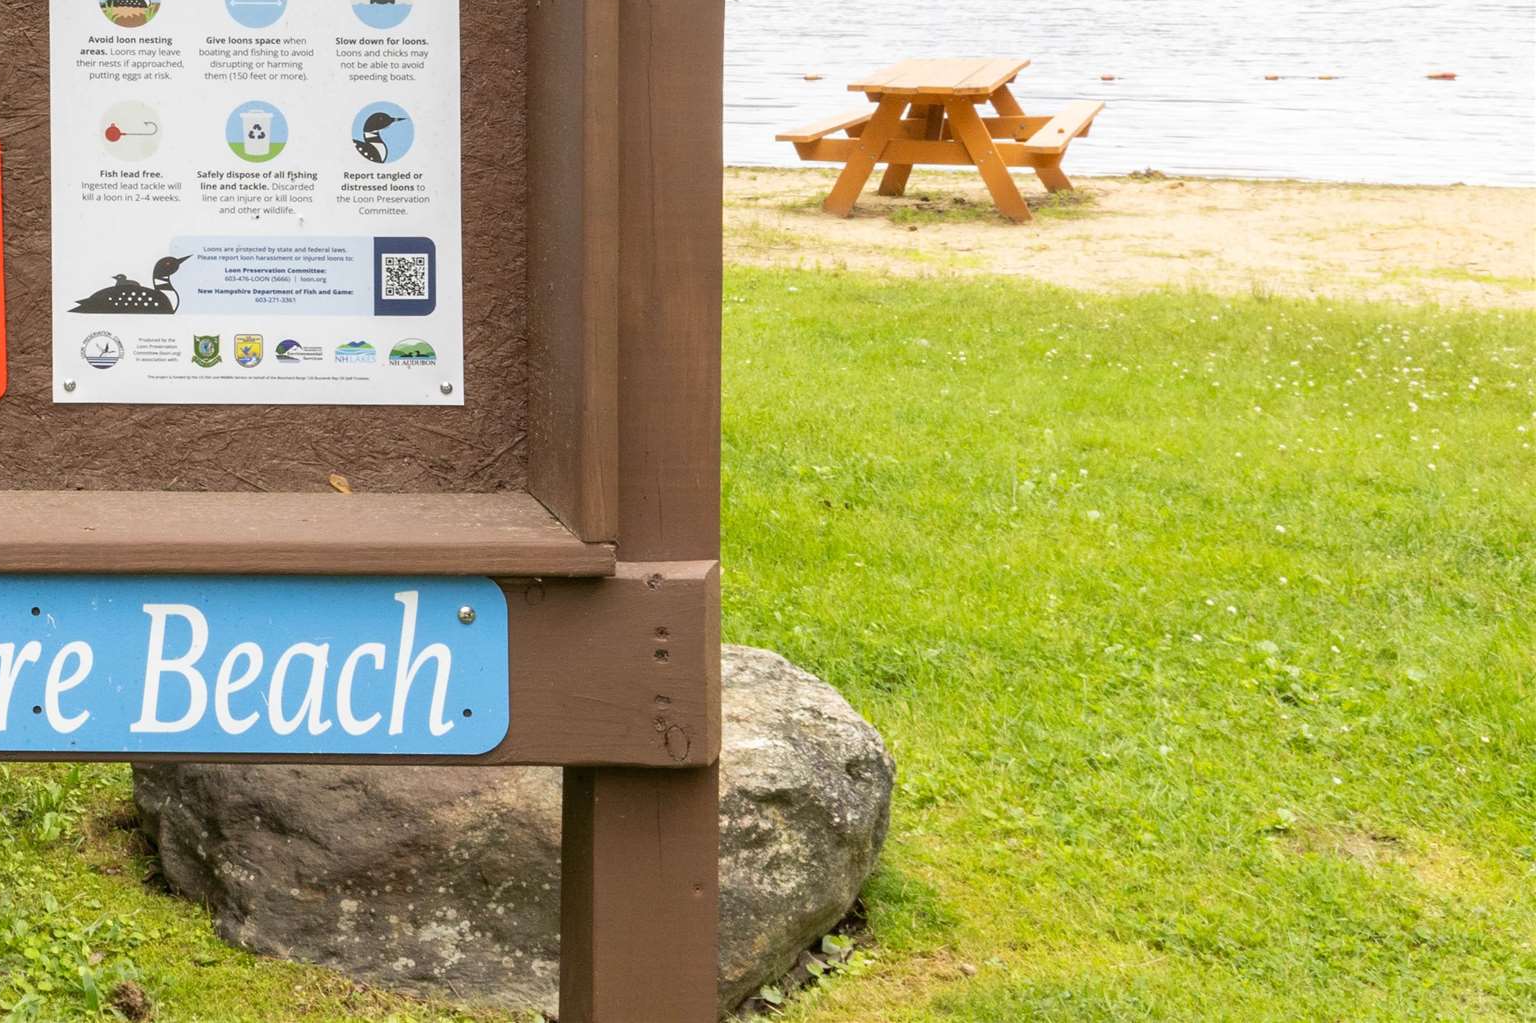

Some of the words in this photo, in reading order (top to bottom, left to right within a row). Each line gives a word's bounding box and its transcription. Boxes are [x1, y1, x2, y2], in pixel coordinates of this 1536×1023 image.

[88, 35, 114, 43] Avoid
[116, 35, 136, 43] loon
[139, 35, 172, 46] nesting
[206, 36, 226, 44] Give
[228, 36, 252, 44] loons
[256, 38, 280, 46] space
[283, 36, 306, 44] when
[336, 36, 356, 45] Slow
[359, 36, 384, 45] down
[387, 36, 400, 45] for
[402, 36, 429, 45] loons.
[111, 47, 136, 55] Loons
[138, 49, 156, 57] may
[159, 47, 180, 55] leave
[199, 47, 231, 58] boating
[232, 47, 248, 56] and
[251, 47, 278, 58] fishing
[292, 47, 314, 56] avoid
[336, 48, 362, 56] Loons
[364, 48, 380, 56] and
[383, 48, 408, 56] chicks
[410, 50, 428, 59] may
[76, 59, 96, 67] their
[124, 59, 130, 67] if
[132, 59, 185, 69] approached,
[210, 59, 253, 70] disrupting
[267, 59, 303, 70] harming
[358, 60, 368, 68] be
[370, 60, 388, 68] able
[402, 60, 424, 68] avoid
[89, 71, 120, 81] putting
[122, 73, 141, 81] eggs
[154, 71, 171, 79] risk.
[204, 71, 227, 80] them
[229, 71, 248, 82] (150
[250, 71, 266, 80] feet
[280, 71, 307, 82] more).
[350, 72, 388, 83] speeding
[390, 72, 416, 80] boats.
[100, 169, 118, 178] Fish
[121, 169, 140, 178] lead
[143, 169, 163, 178] free.
[197, 170, 224, 180] Safely
[226, 170, 260, 180] dispose
[263, 170, 272, 178] of
[274, 170, 284, 178] all
[288, 170, 318, 180] fishing
[344, 171, 374, 181] Report
[377, 171, 410, 181] tangled
[82, 181, 118, 192] Ingested
[120, 181, 138, 190] lead
[140, 181, 165, 190] tackle
[168, 181, 181, 190] will
[201, 182, 217, 190] line
[220, 182, 236, 190] and
[239, 182, 270, 190] tackle.
[272, 182, 314, 190] Discarded
[341, 182, 387, 191] distressed
[390, 182, 414, 191] loons
[82, 193, 94, 201] kill
[104, 193, 122, 201] loon
[125, 193, 132, 201] in
[152, 193, 181, 201] weeks.
[202, 193, 217, 202] line
[237, 193, 262, 204] injure
[276, 193, 287, 202] kill
[290, 193, 312, 202] loons
[336, 194, 350, 203] the
[353, 194, 374, 203] Loon
[377, 194, 430, 203] Preservation
[219, 205, 235, 214] and
[238, 205, 260, 214] other
[263, 205, 296, 214] wildlife.
[359, 206, 408, 214] Committee.
[236, 246, 266, 254] protected
[268, 246, 275, 254] by
[130, 592, 454, 736] Beach
